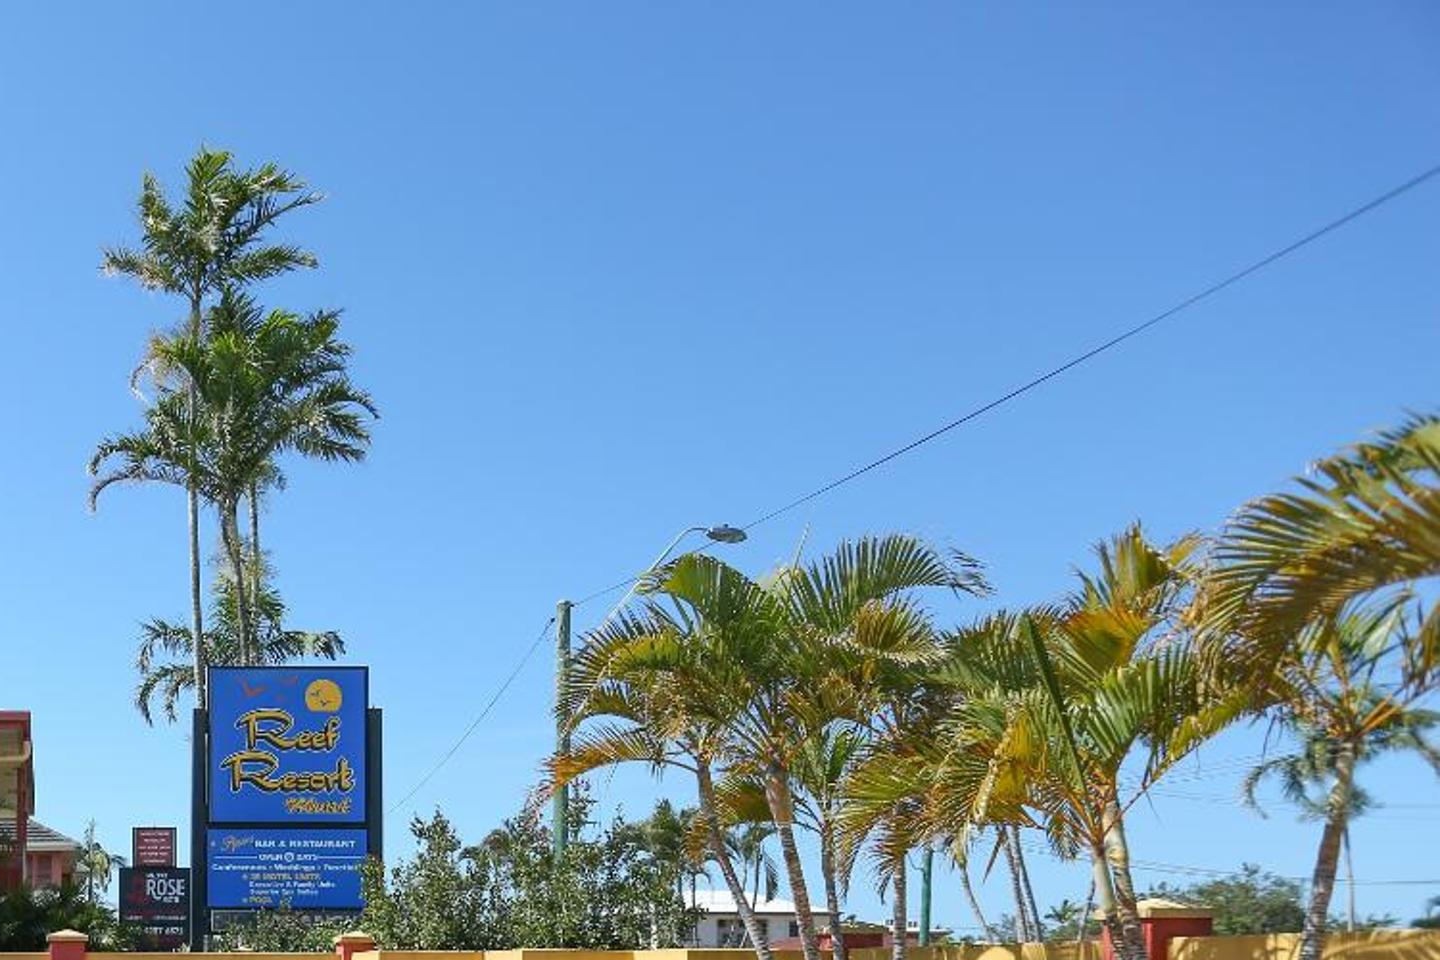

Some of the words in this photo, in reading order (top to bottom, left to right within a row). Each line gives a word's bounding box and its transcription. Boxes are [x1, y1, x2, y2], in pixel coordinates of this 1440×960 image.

[235, 709, 342, 752] Reef
[220, 750, 354, 792] Resort
[289, 840, 356, 848] RESTAURANT
[146, 879, 185, 900] ROSE
